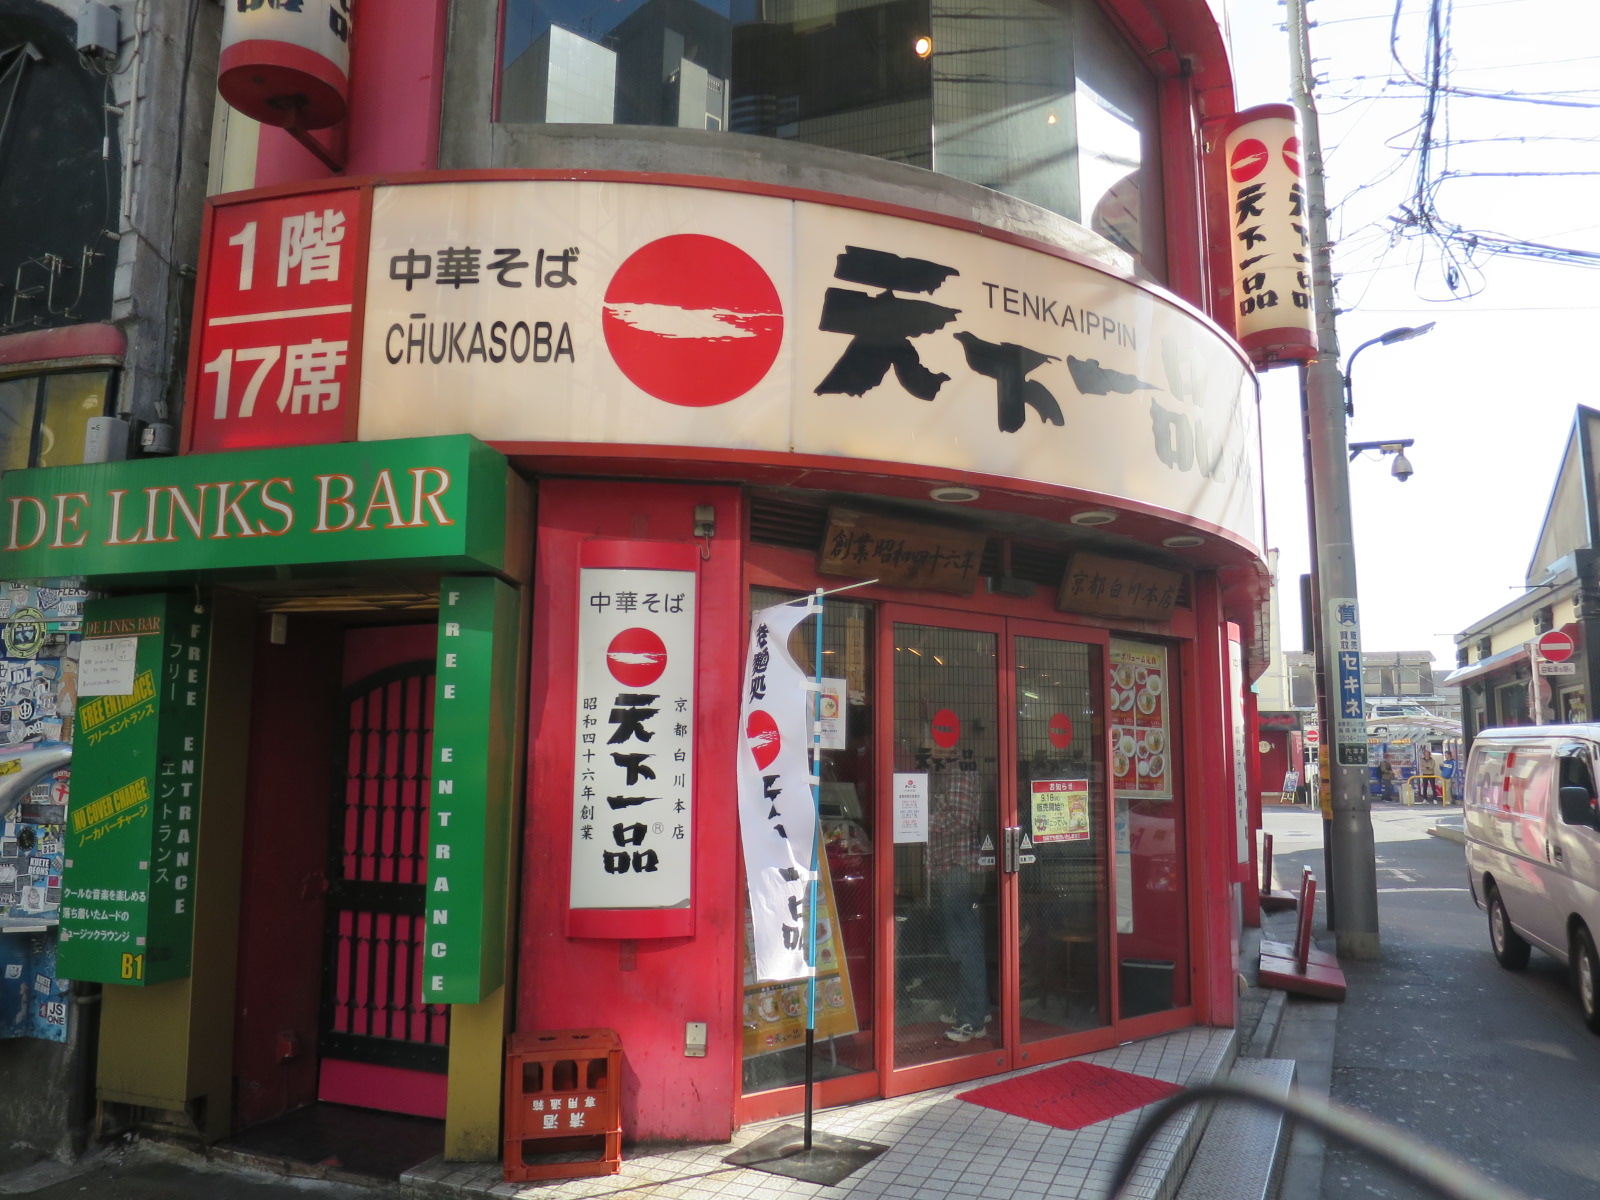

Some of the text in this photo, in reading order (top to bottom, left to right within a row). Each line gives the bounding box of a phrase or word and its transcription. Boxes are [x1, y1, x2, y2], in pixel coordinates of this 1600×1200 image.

[229, 209, 346, 291] 1階
[389, 246, 580, 292] 中華そば
[1236, 182, 1278, 316] 天下一品
[981, 281, 1138, 352] TENKAIPPIN
[204, 338, 348, 420] 17席
[814, 245, 1226, 484] 天下一品
[4, 466, 455, 552] DE LINKS BAR
[590, 591, 686, 614] 中華そば
[1070, 570, 1176, 610] 京都白川本店
[86, 616, 160, 635] DE LINKS BAR
[1342, 653, 1361, 717] セキネ
[81, 699, 105, 730] FREE
[88, 703, 154, 746] フリーエントランス
[155, 643, 183, 884] フリー エントランス
[175, 624, 202, 914] FREE ENTRANCE
[580, 697, 597, 840] 昭和四十六年創業
[603, 693, 662, 875] 天下一品
[672, 697, 688, 840] 京都白川本店
[1050, 782, 1073, 791] お知らせ
[74, 779, 148, 831] NO COVER CHARGE
[431, 592, 460, 990] FREE ENTRANCE
[79, 803, 148, 848] ノーカバーチャージ
[62, 907, 130, 922] 落ち着いたムードの
[64, 888, 147, 903] クールな音楽を楽しめる
[121, 953, 144, 980] B1
[50, 1003, 63, 1016] JS
[543, 1112, 585, 1129] 清酒
